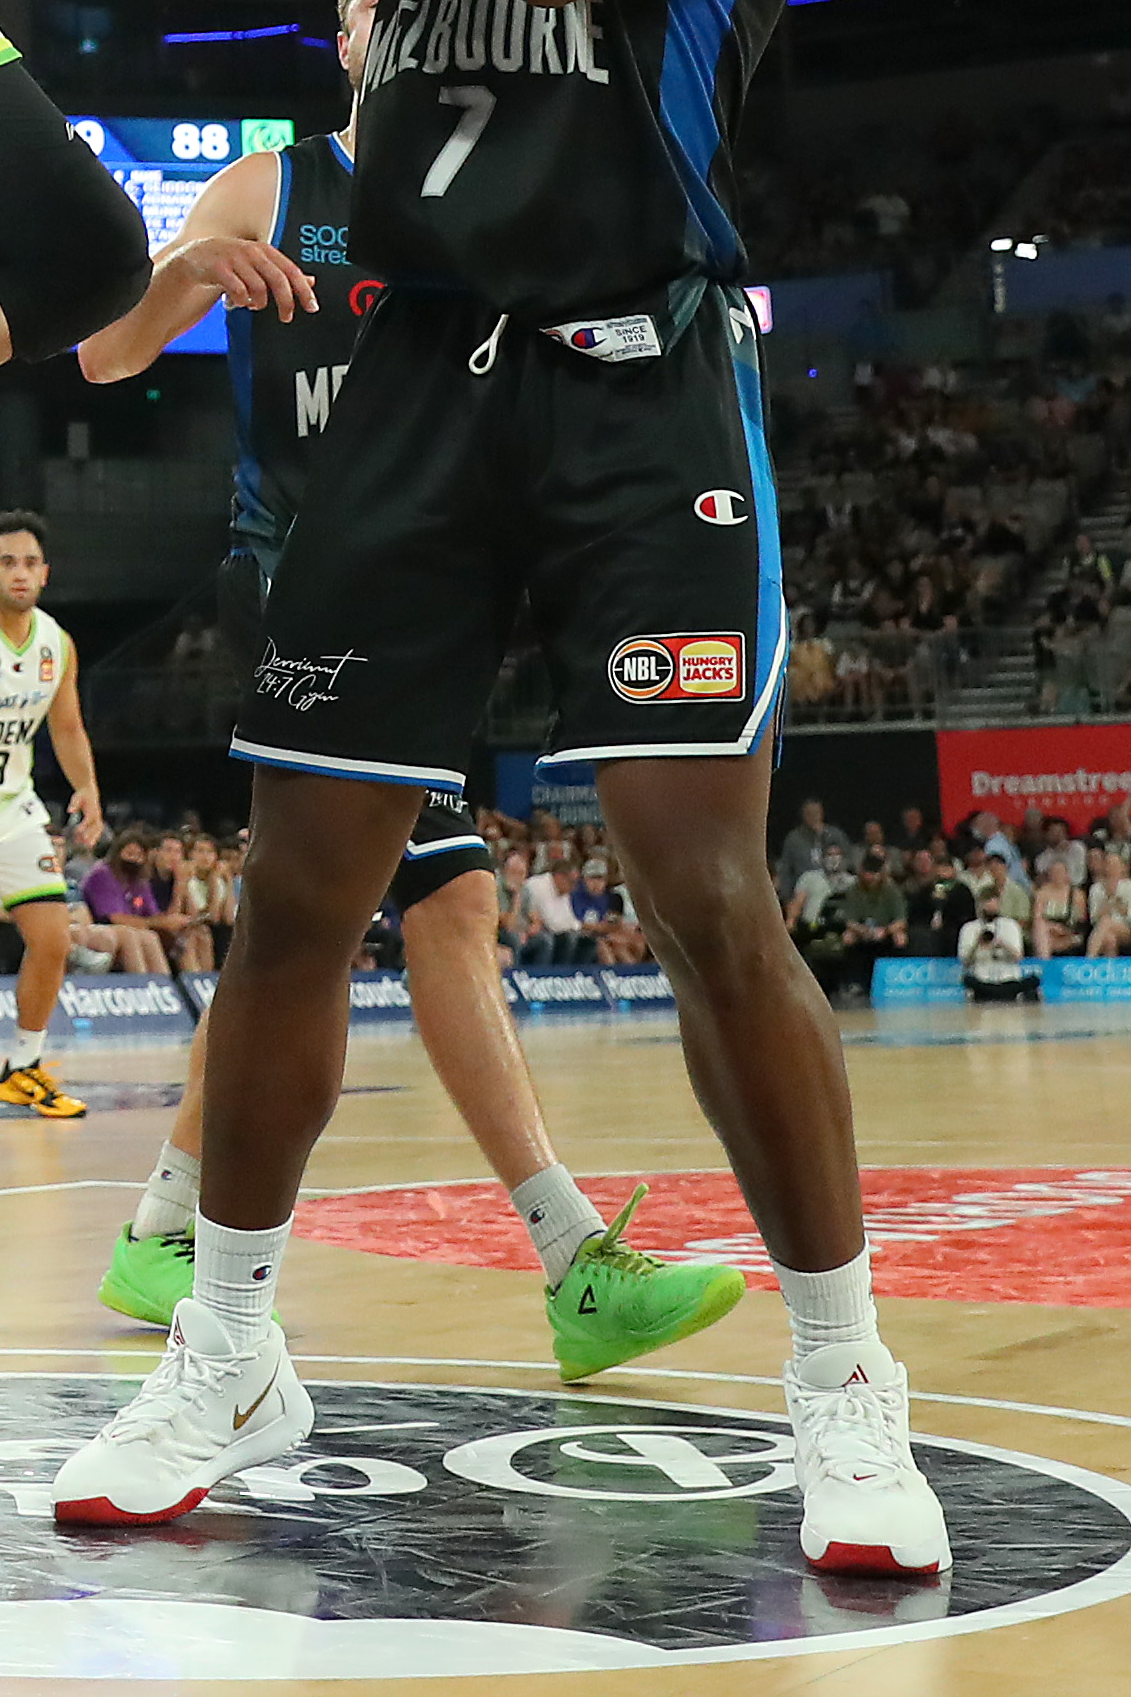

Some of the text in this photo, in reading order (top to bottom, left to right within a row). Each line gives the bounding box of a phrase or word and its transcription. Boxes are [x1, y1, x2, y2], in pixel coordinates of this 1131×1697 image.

[171, 122, 231, 161] 88
[420, 84, 498, 198] 7
[614, 324, 648, 338] SINCE
[622, 333, 646, 344] 1919
[623, 655, 661, 682] NBL
[682, 656, 735, 667] HUNGRY
[57, 980, 182, 1018] Harcourts
